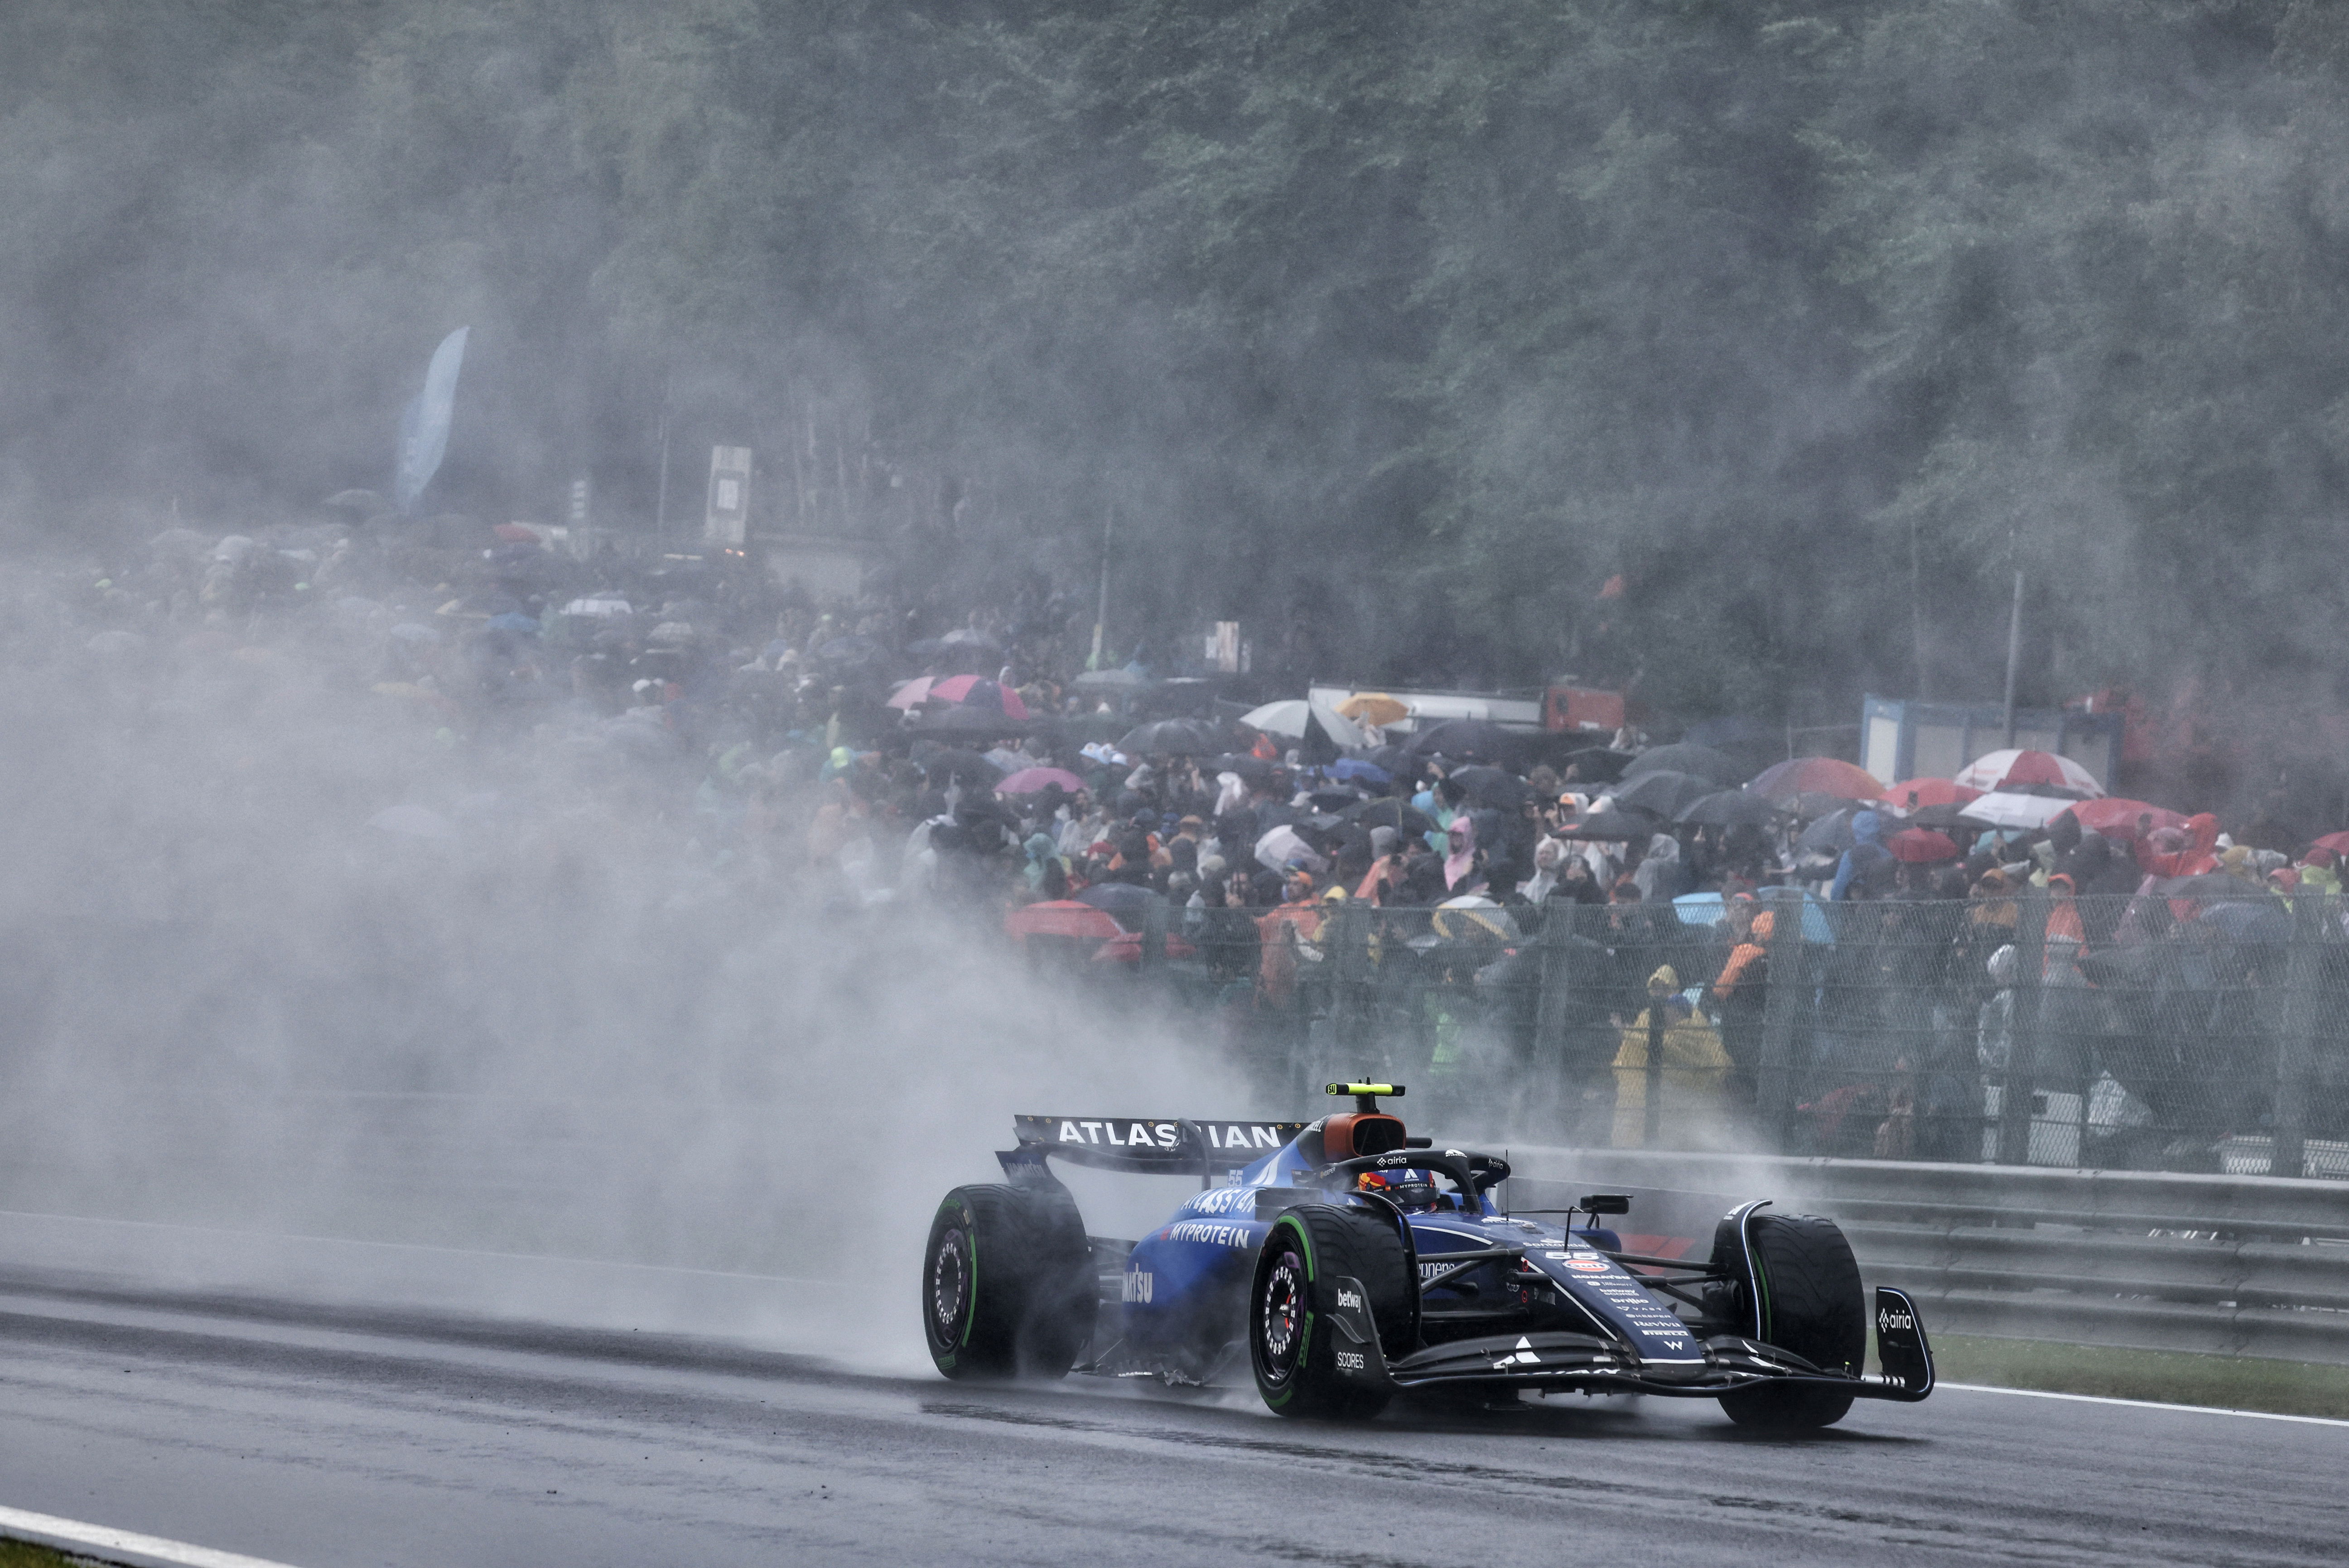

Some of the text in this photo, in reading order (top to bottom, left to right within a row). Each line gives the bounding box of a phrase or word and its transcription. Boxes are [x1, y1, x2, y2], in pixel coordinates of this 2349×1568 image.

[1059, 1121, 1281, 1148] ATLASIAN
[1387, 1156, 1407, 1165] airia
[1228, 1169, 1244, 1187] 55
[1323, 1167, 1336, 1177] KEEPER
[1170, 1224, 1250, 1249] MYPROTEIN
[1545, 1251, 1599, 1260] 55
[1338, 1288, 1361, 1313] betway
[1890, 1309, 1911, 1330] airia
[1337, 1352, 1364, 1369] SCORES
